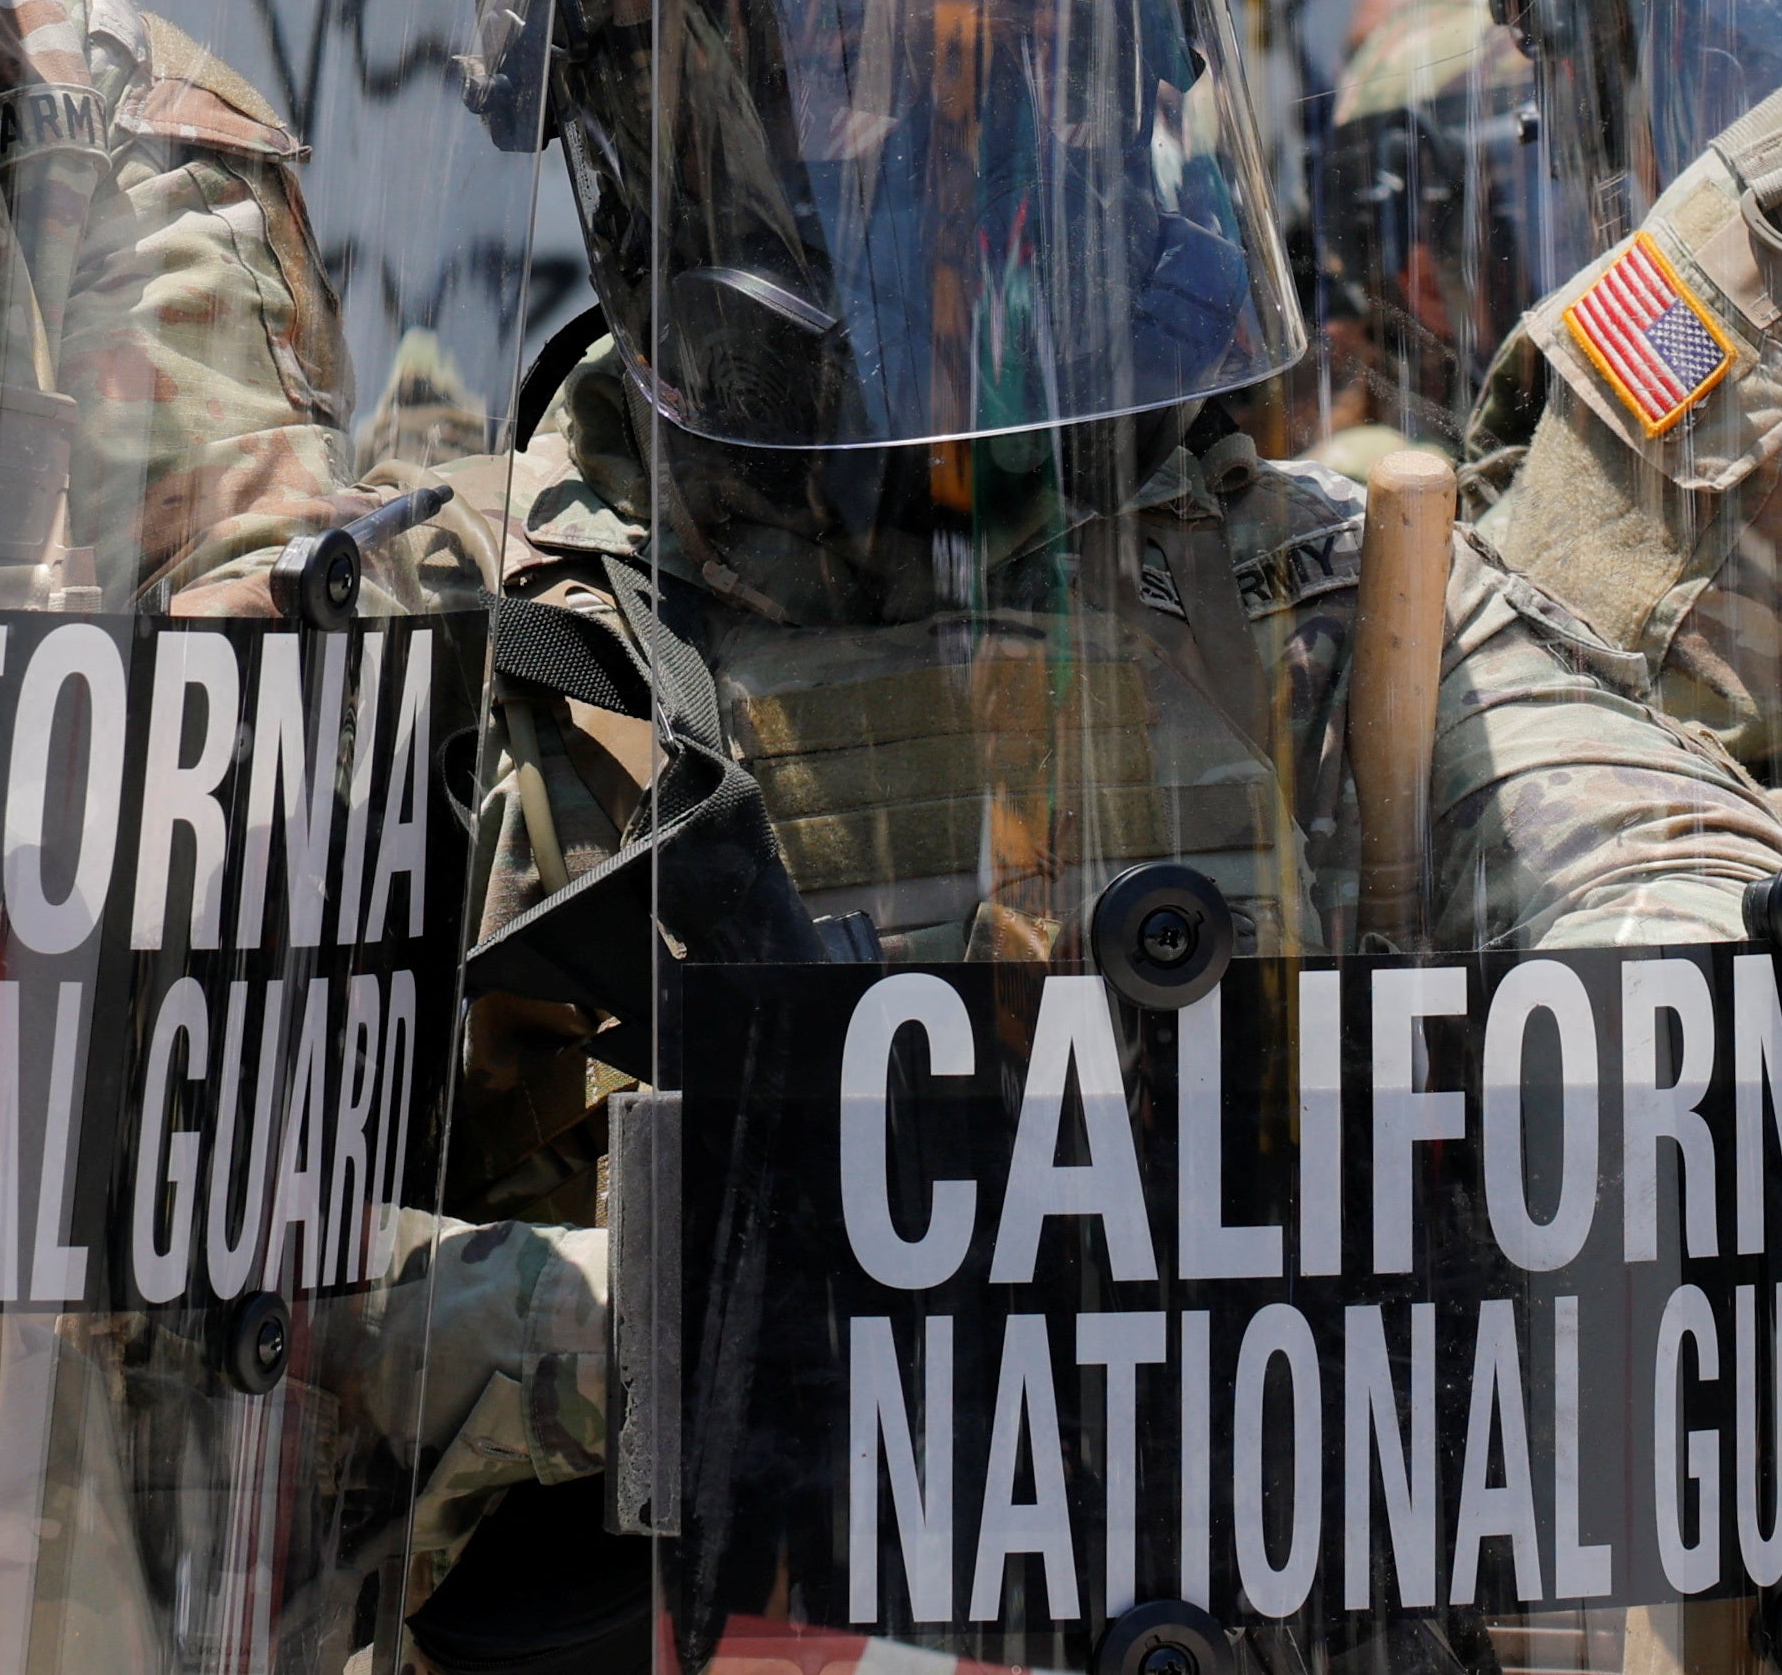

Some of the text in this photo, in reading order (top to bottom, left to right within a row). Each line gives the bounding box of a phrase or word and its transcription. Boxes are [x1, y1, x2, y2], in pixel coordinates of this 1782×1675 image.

[0, 92, 108, 154] ARM
[1236, 535, 1335, 607] RMY
[132, 967, 418, 1305] GUARD
[849, 1294, 1612, 1624] NATIONAL
